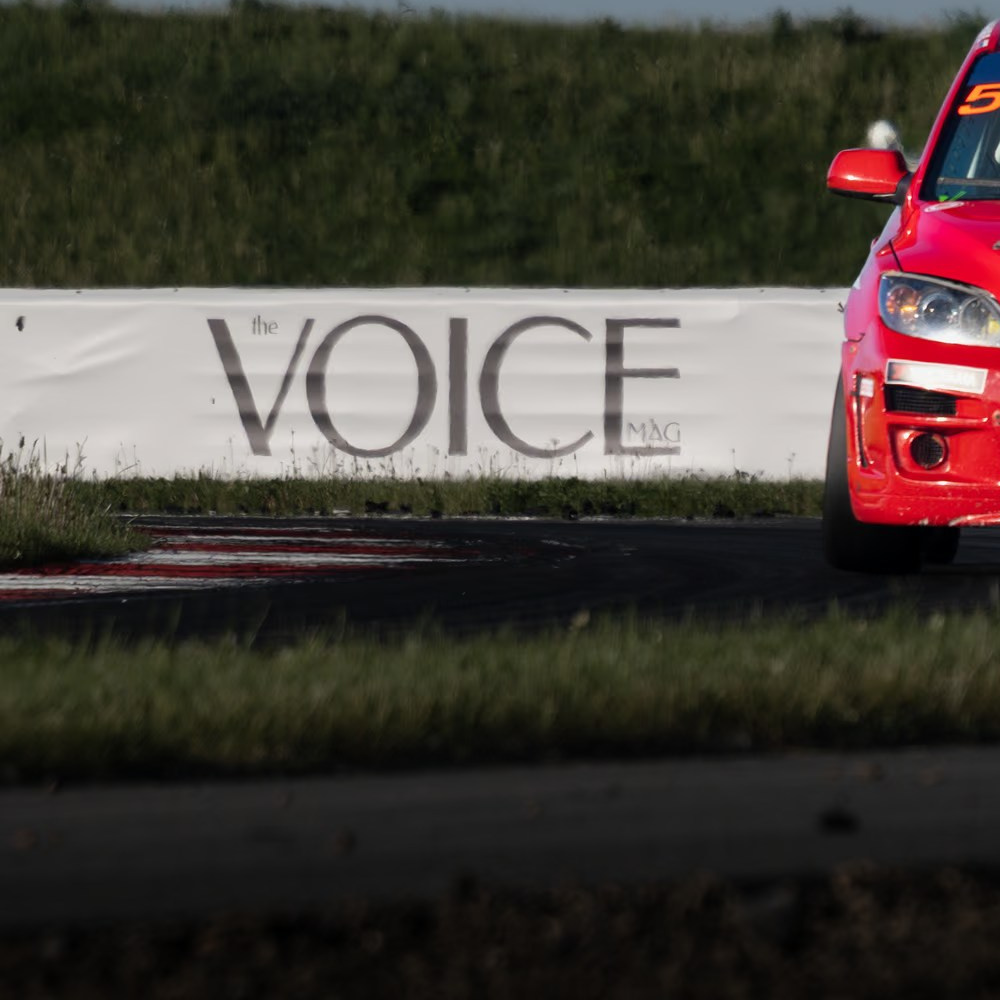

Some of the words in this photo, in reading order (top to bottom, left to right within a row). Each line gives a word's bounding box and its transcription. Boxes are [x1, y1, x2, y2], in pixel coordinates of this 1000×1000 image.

[251, 314, 279, 336] the
[206, 314, 682, 457] VOICE
[626, 420, 681, 443] MAG
